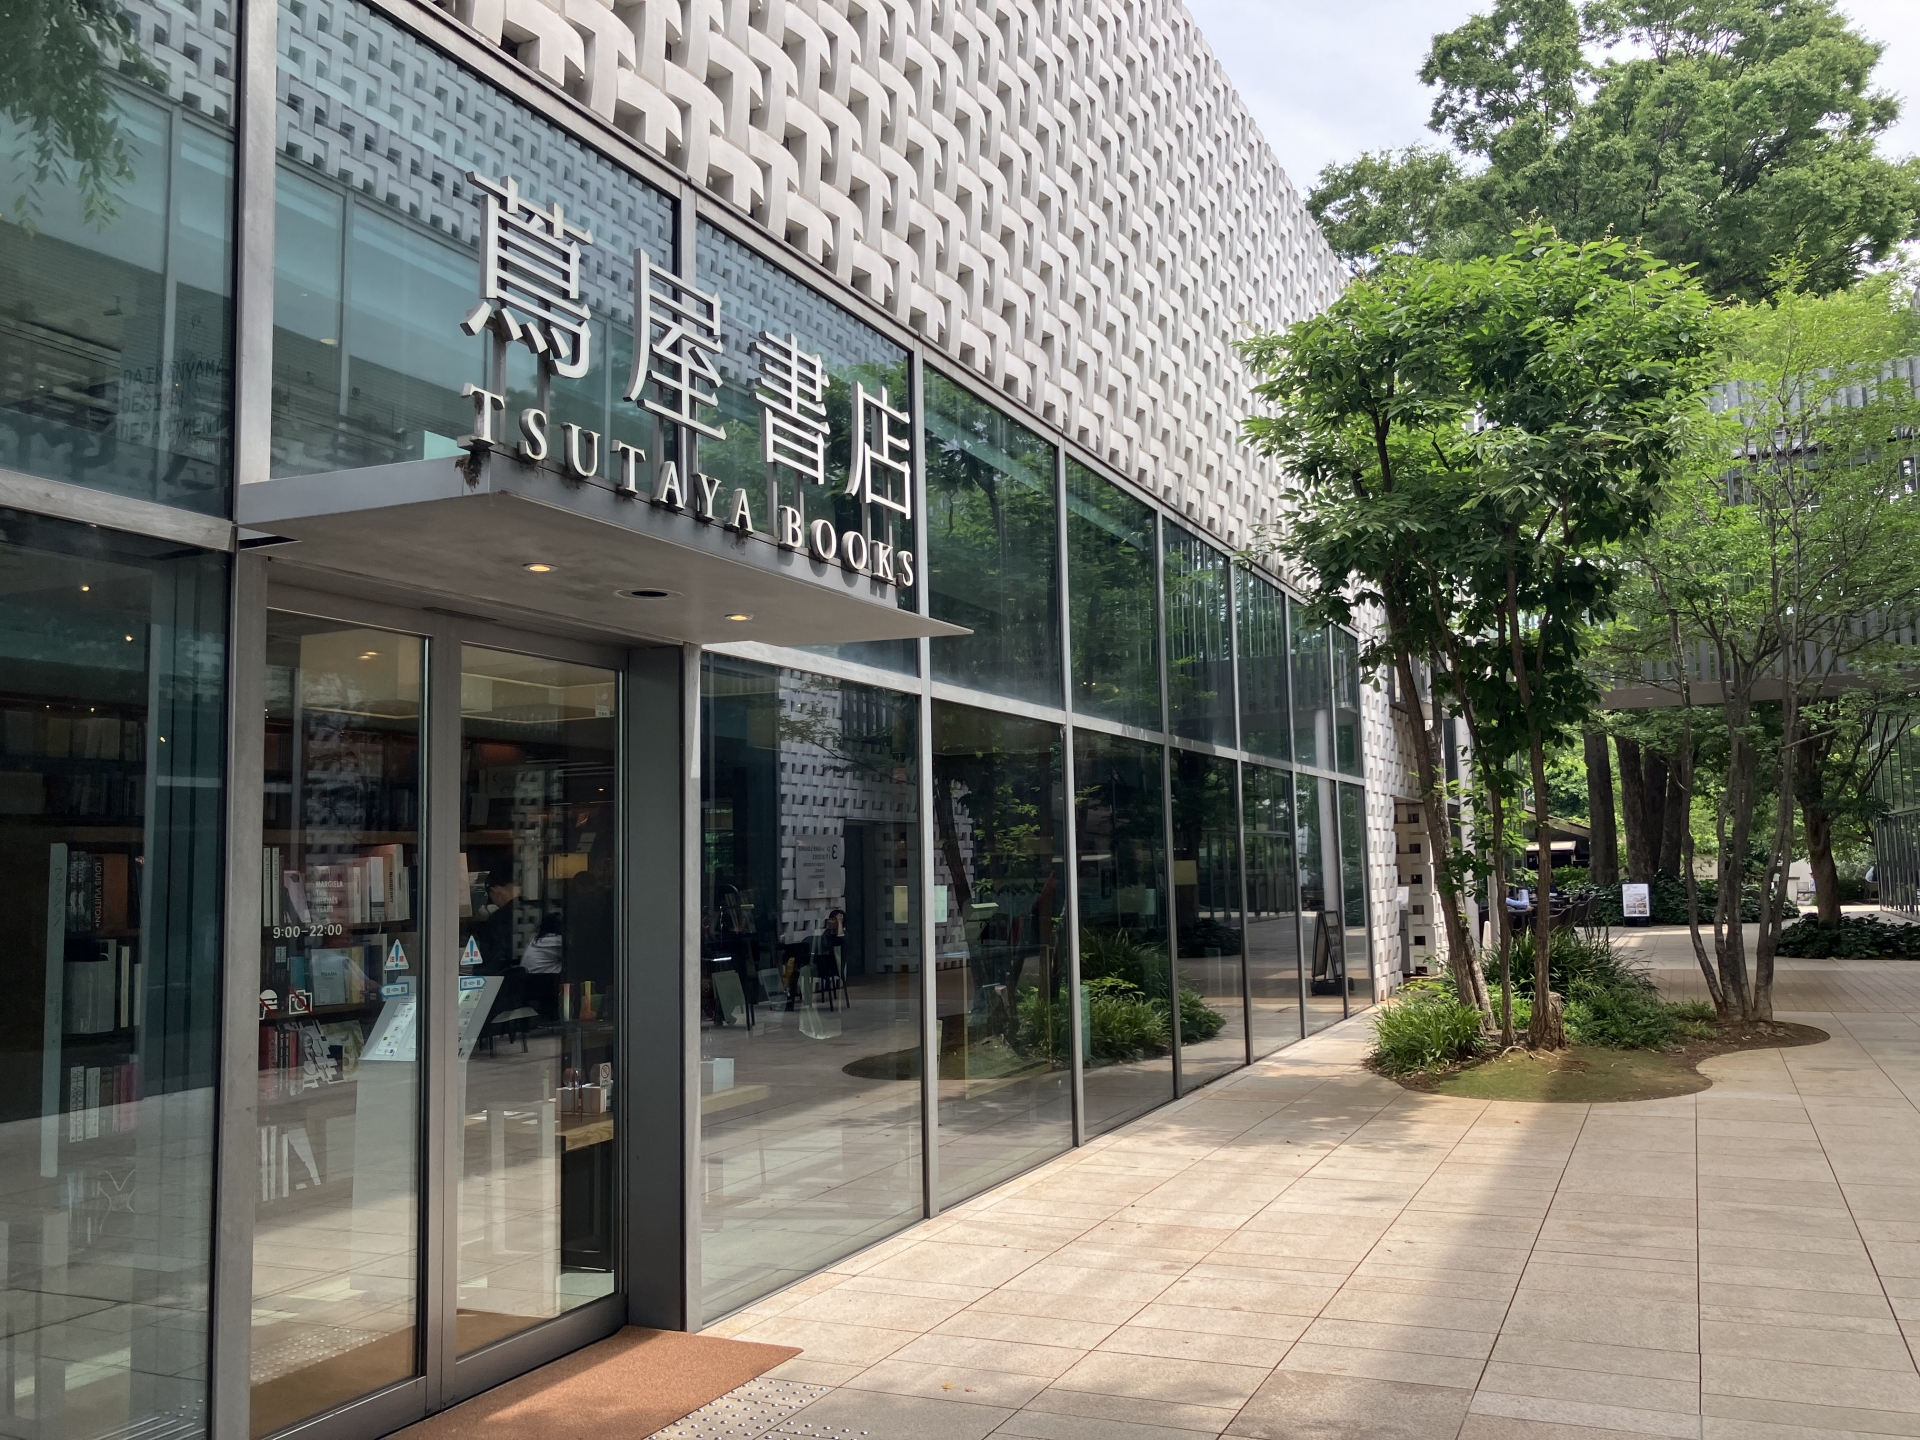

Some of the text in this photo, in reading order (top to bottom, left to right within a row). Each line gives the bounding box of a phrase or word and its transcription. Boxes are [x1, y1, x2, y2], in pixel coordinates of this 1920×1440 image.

[459, 170, 912, 520] 蔦屋書店
[456, 382, 915, 588] TSUTAYA BOOKS
[94, 862, 102, 923] LOUIS VUITTON
[315, 880, 344, 888] MARGIELA
